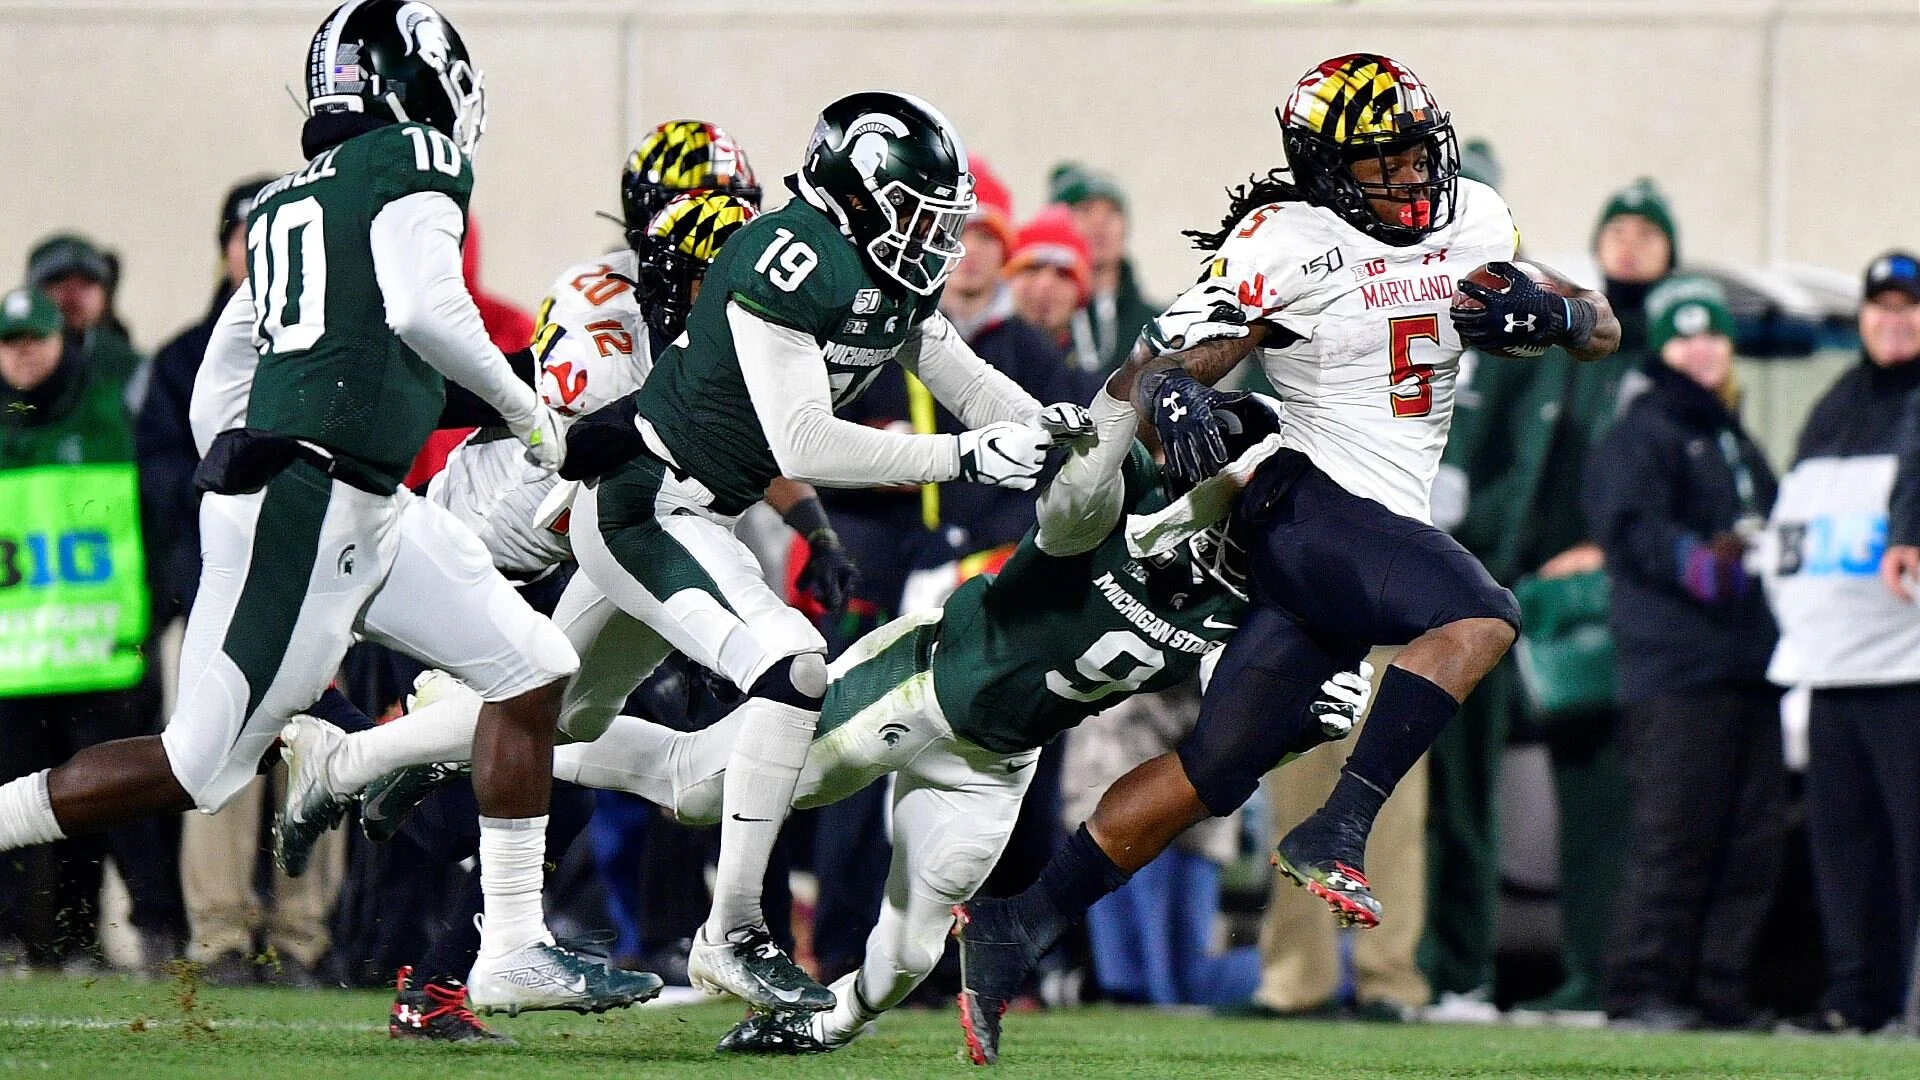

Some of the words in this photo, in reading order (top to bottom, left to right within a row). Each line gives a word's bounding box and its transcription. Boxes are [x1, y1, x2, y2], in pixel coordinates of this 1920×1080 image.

[402, 127, 461, 177] 10
[1237, 203, 1284, 239] 5
[248, 196, 327, 355] 10
[569, 263, 629, 306] 20
[754, 228, 818, 292] 19
[1301, 247, 1344, 284] 150
[1360, 274, 1453, 310] MARYLAND
[585, 320, 633, 357] 12
[1388, 313, 1440, 417] 5
[1093, 571, 1176, 643] MICHIGAN
[1045, 631, 1165, 702] 9
